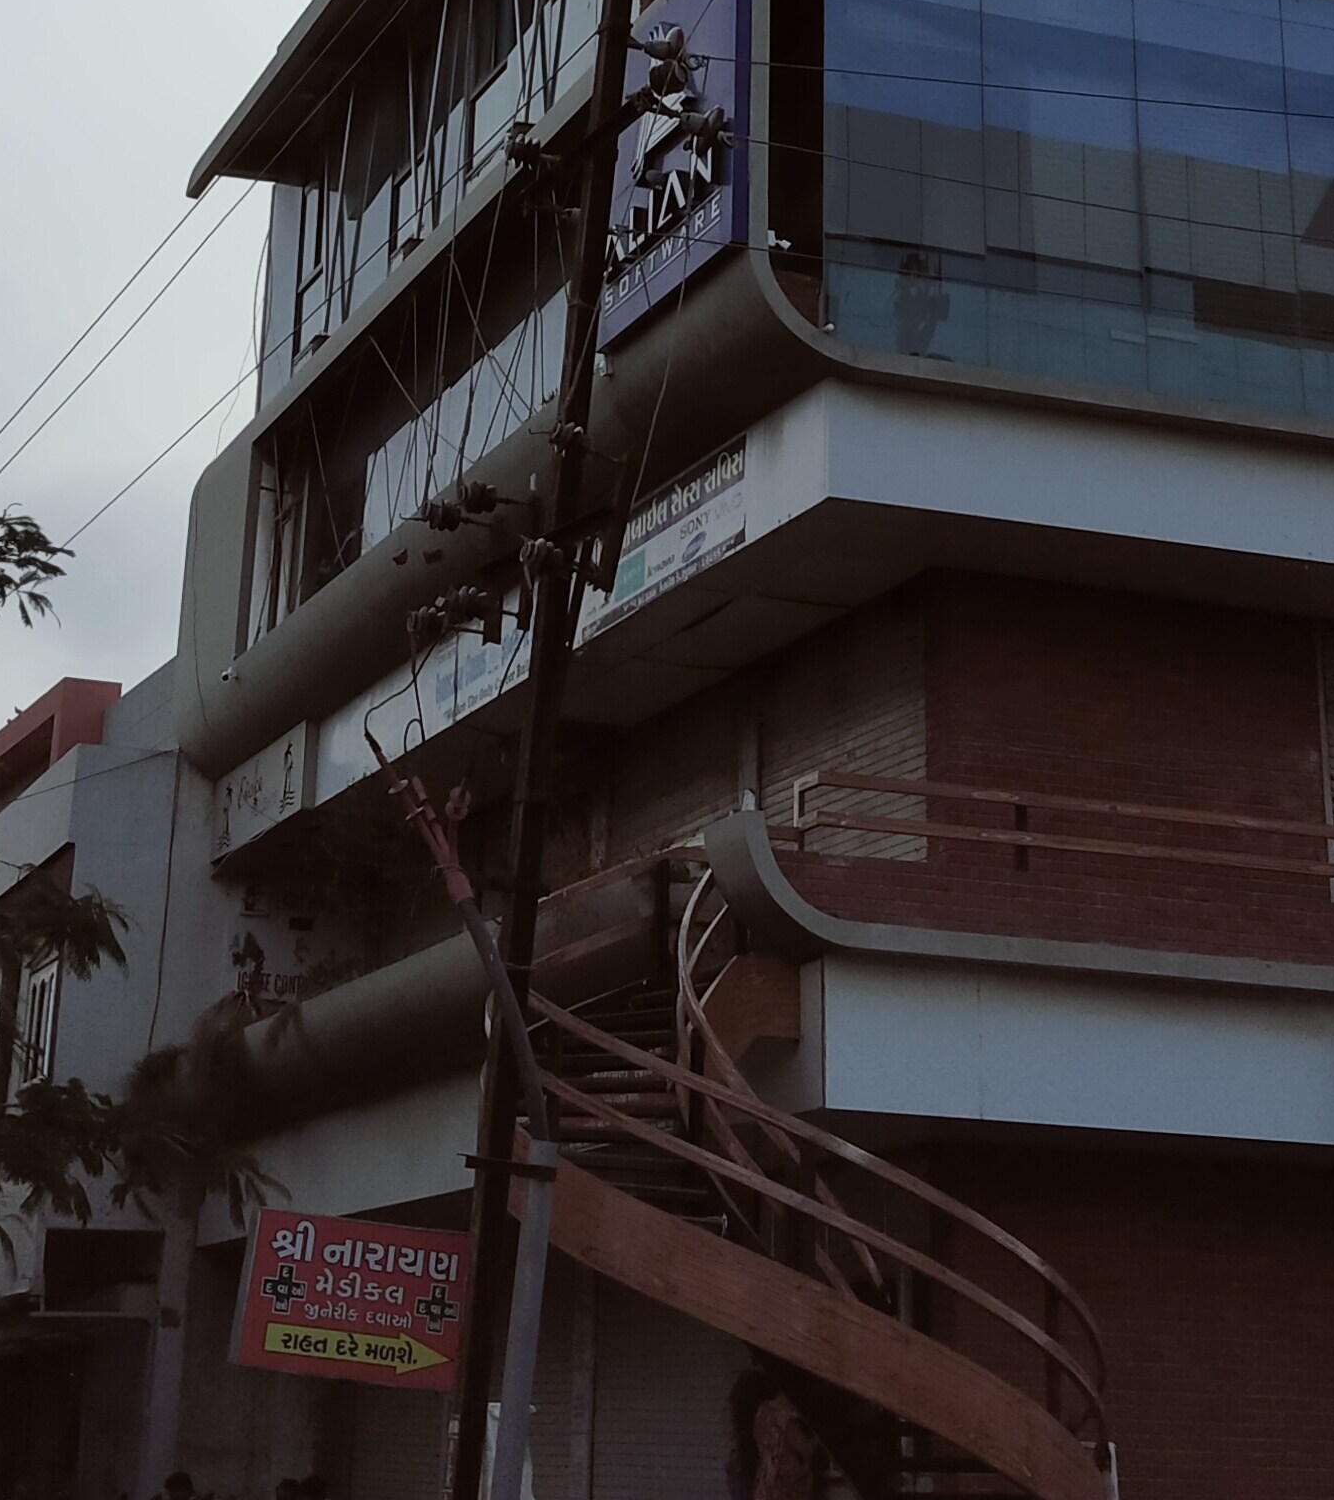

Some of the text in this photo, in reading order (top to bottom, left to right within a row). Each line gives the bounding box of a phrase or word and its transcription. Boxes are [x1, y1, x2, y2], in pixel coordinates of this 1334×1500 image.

[604, 193, 722, 311] SOFTWARE
[271, 1220, 459, 1282] શ્રી નારાયણ
[315, 1267, 404, 1305] મેડીકલ
[304, 1302, 413, 1330] જીનેરીક દવાઓ
[281, 1332, 418, 1365] રાહત દરે મળશે.
